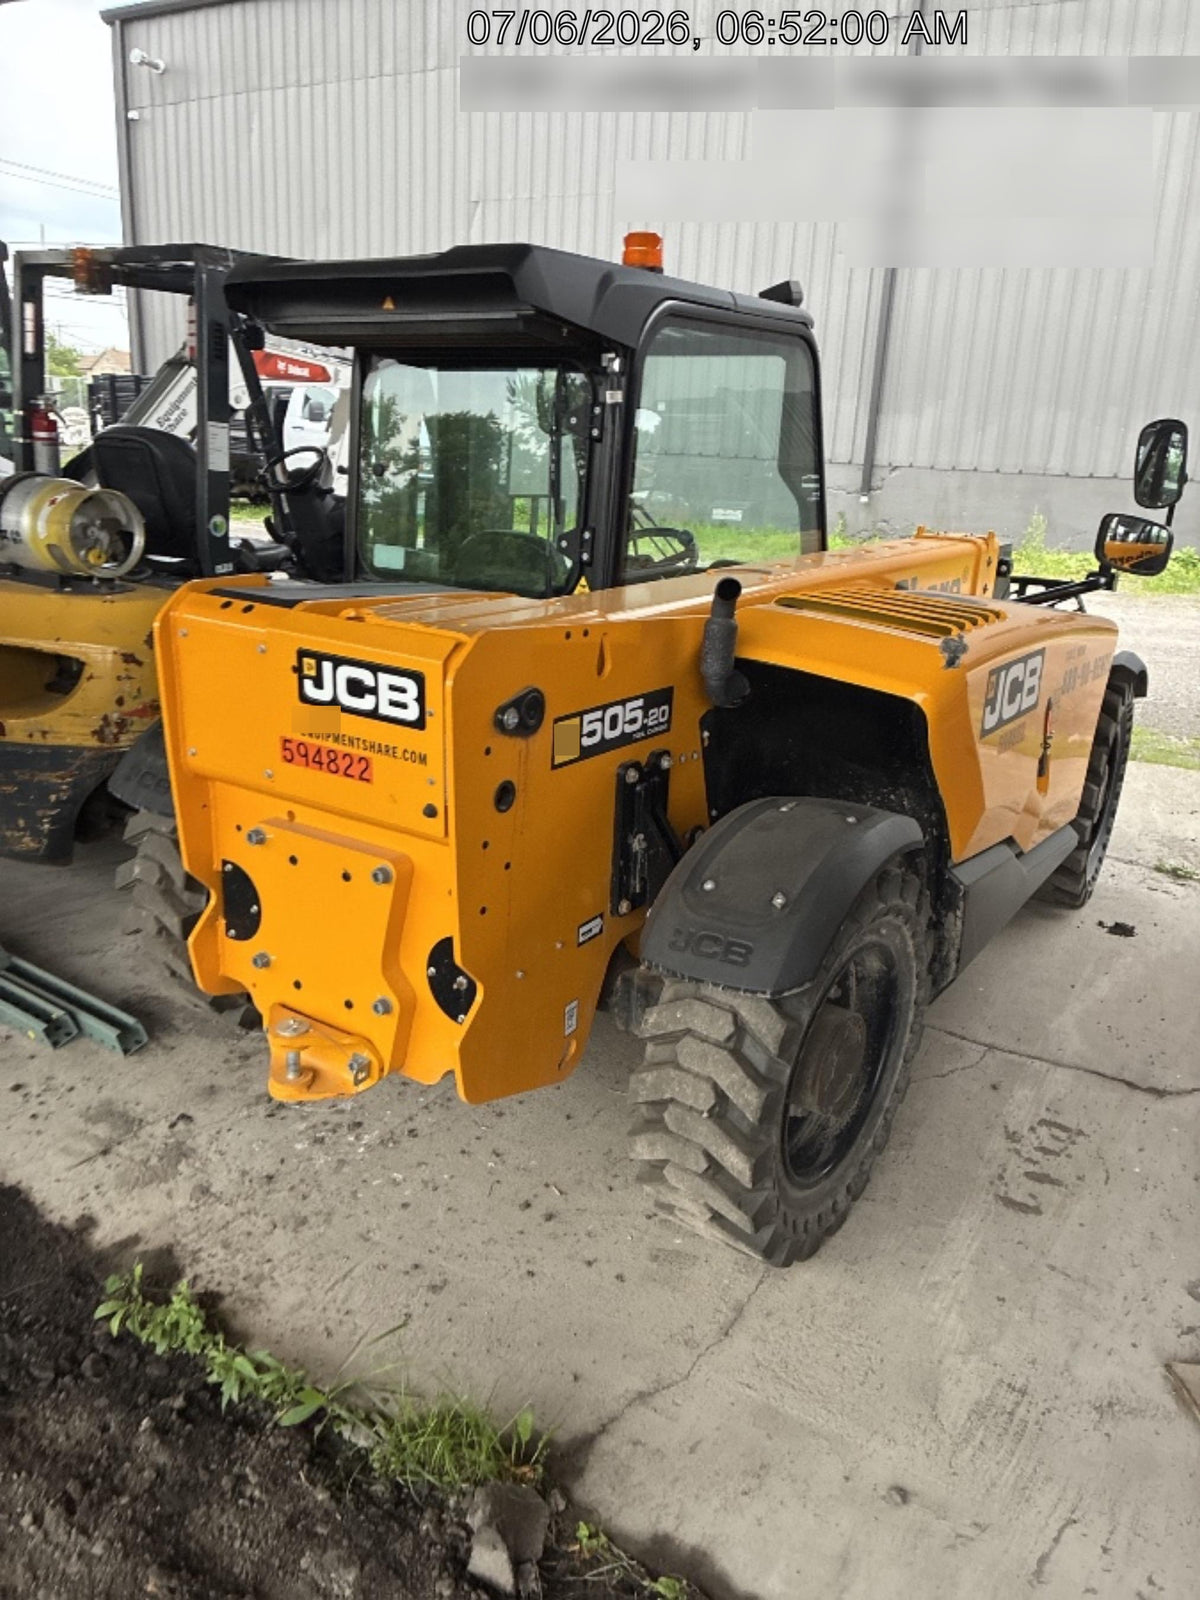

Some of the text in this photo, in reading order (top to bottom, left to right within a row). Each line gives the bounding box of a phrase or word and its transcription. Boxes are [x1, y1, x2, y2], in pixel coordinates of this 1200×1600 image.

[303, 660, 420, 722] JCB
[984, 655, 1044, 730] JCB
[281, 738, 371, 783] 594822
[668, 928, 754, 968] JCB
